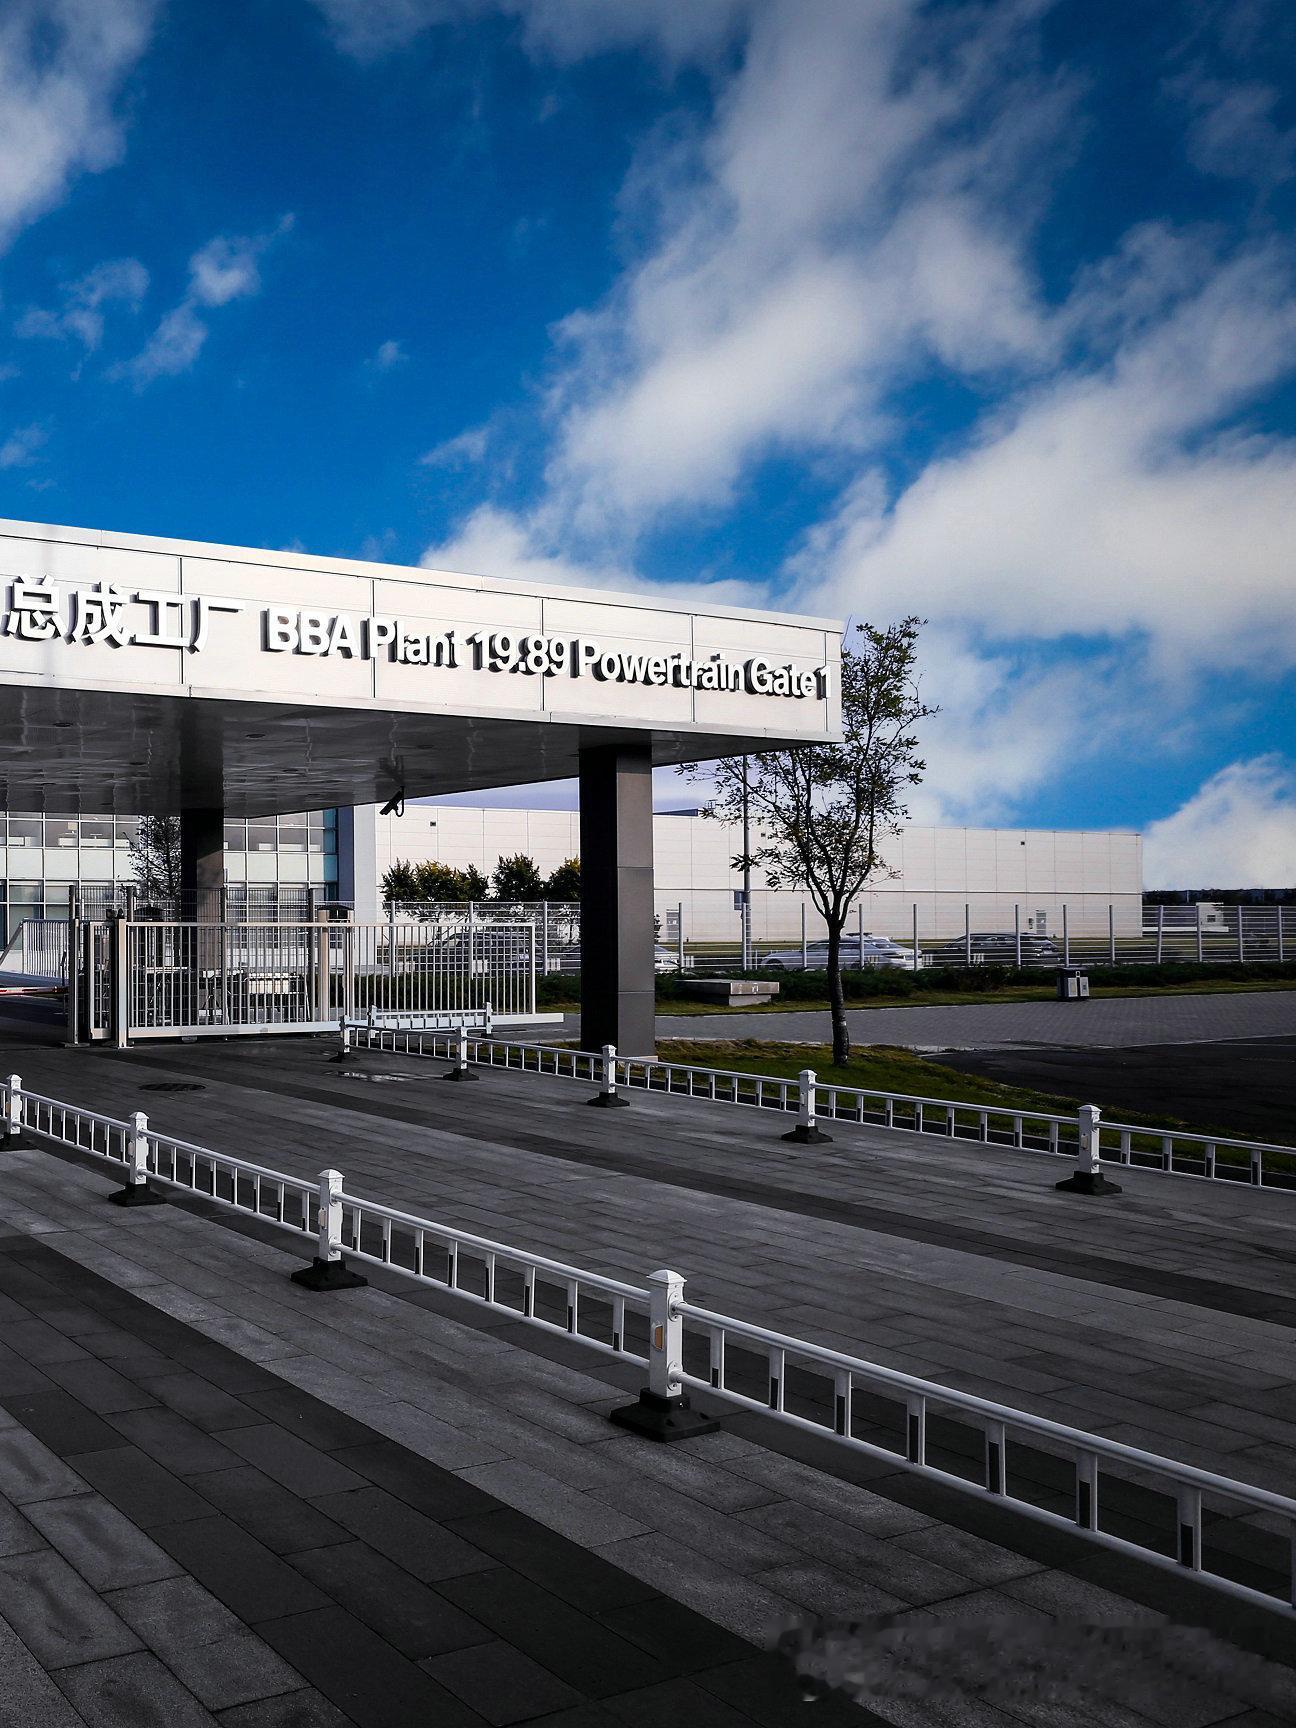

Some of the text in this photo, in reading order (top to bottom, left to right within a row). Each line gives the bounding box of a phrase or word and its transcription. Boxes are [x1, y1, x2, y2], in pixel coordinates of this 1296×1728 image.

[266, 607, 832, 699] BBA Plant 19.89 Powertrain Gate 1
